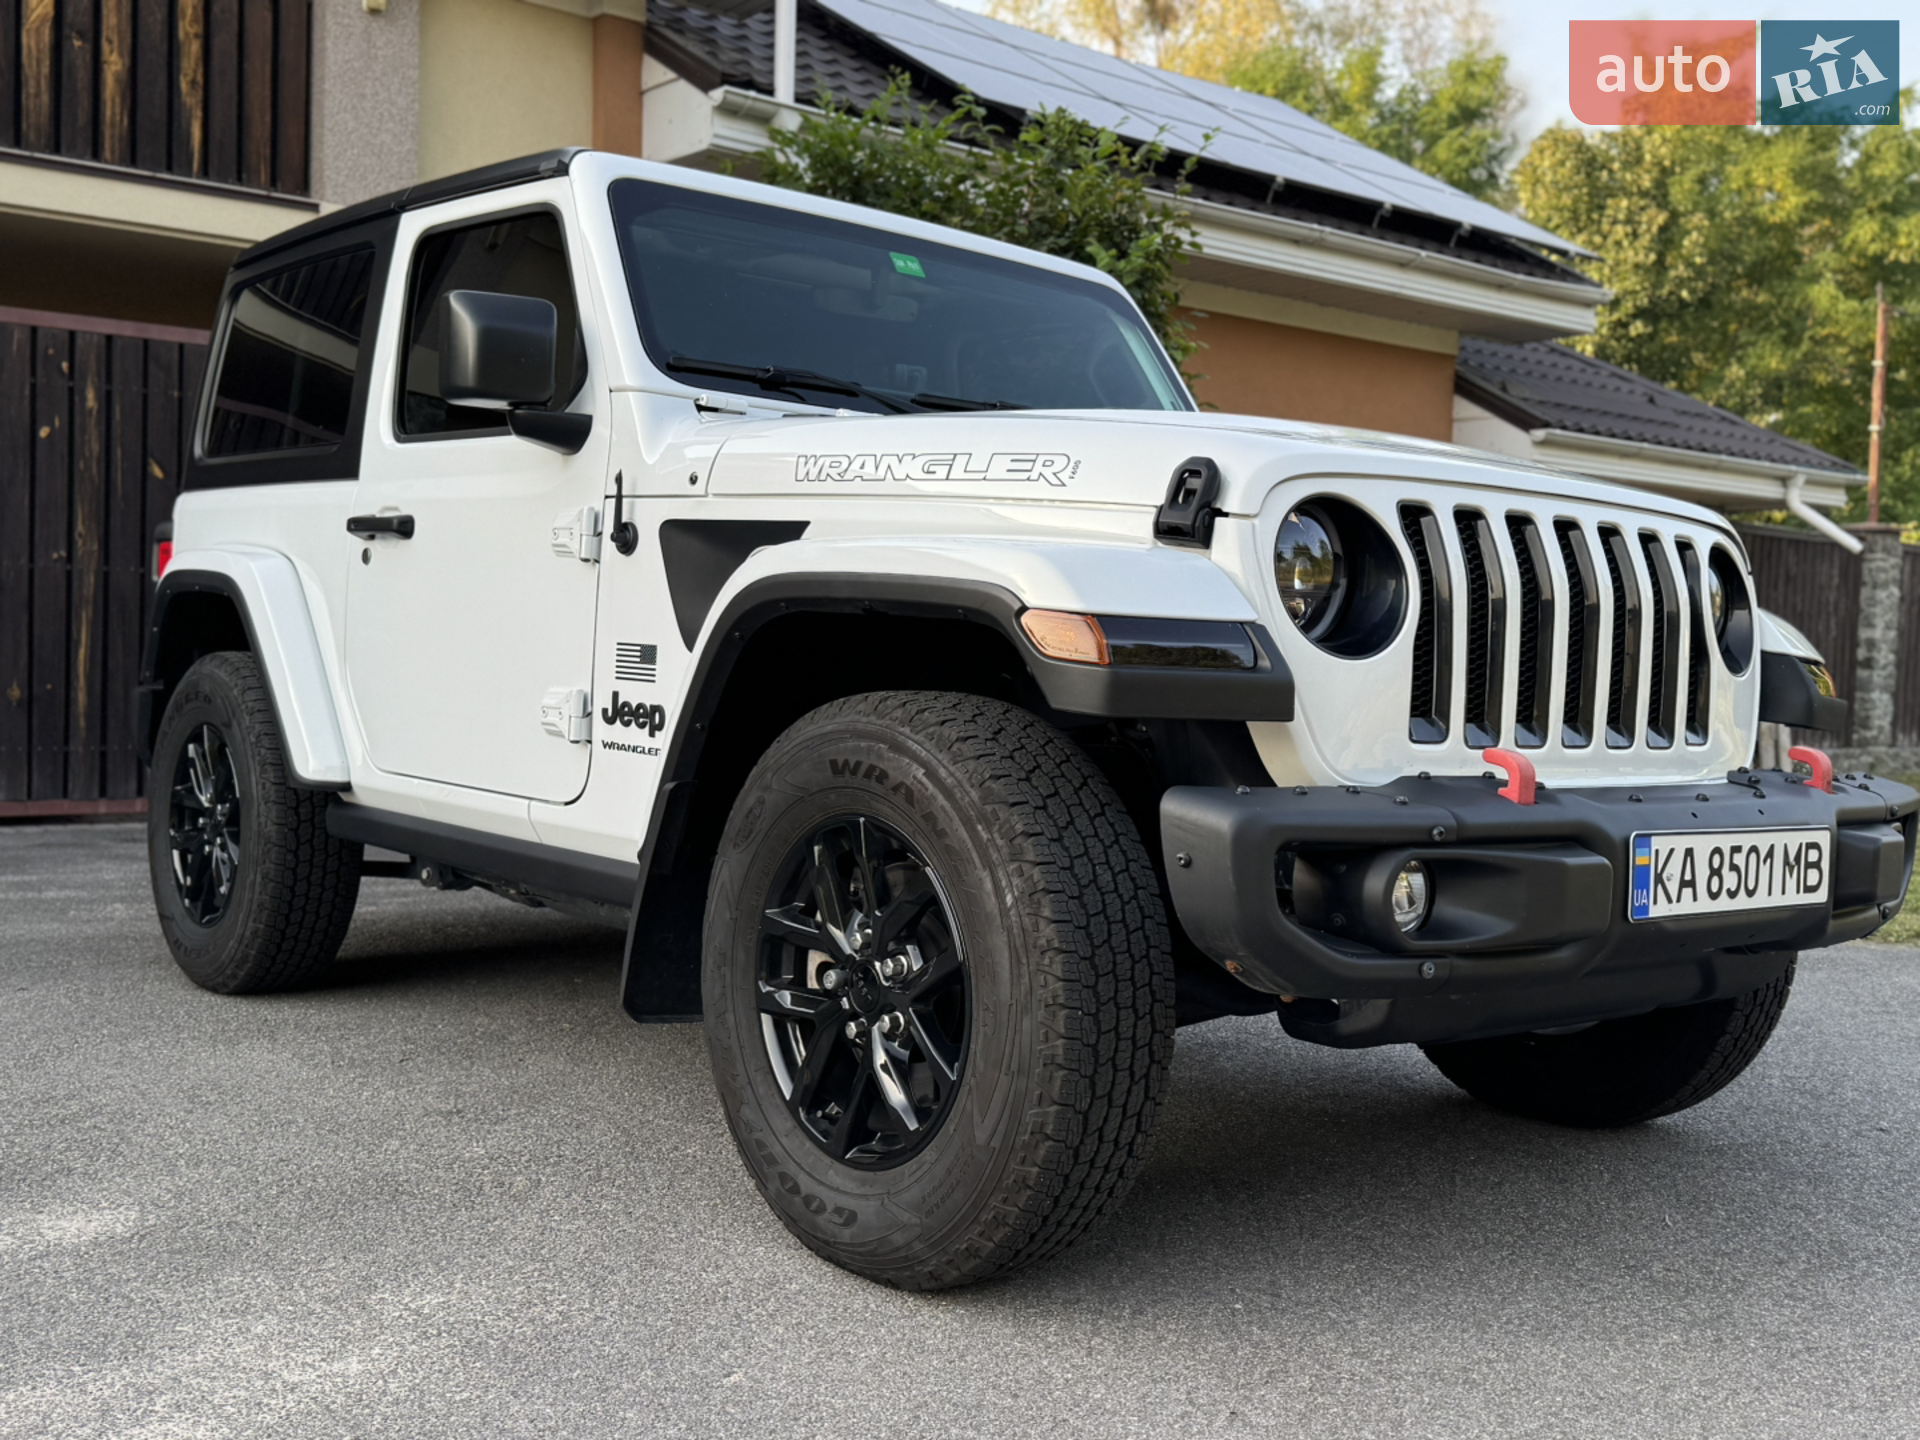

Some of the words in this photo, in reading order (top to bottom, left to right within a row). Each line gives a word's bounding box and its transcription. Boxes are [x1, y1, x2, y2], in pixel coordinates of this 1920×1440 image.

[795, 453, 1070, 487] WRANGLER
[602, 690, 666, 738] Jeep
[1653, 847, 1698, 905] KA
[1706, 843, 1775, 901] 8501
[1781, 841, 1823, 896] MB
[1633, 888, 1649, 907] UA
